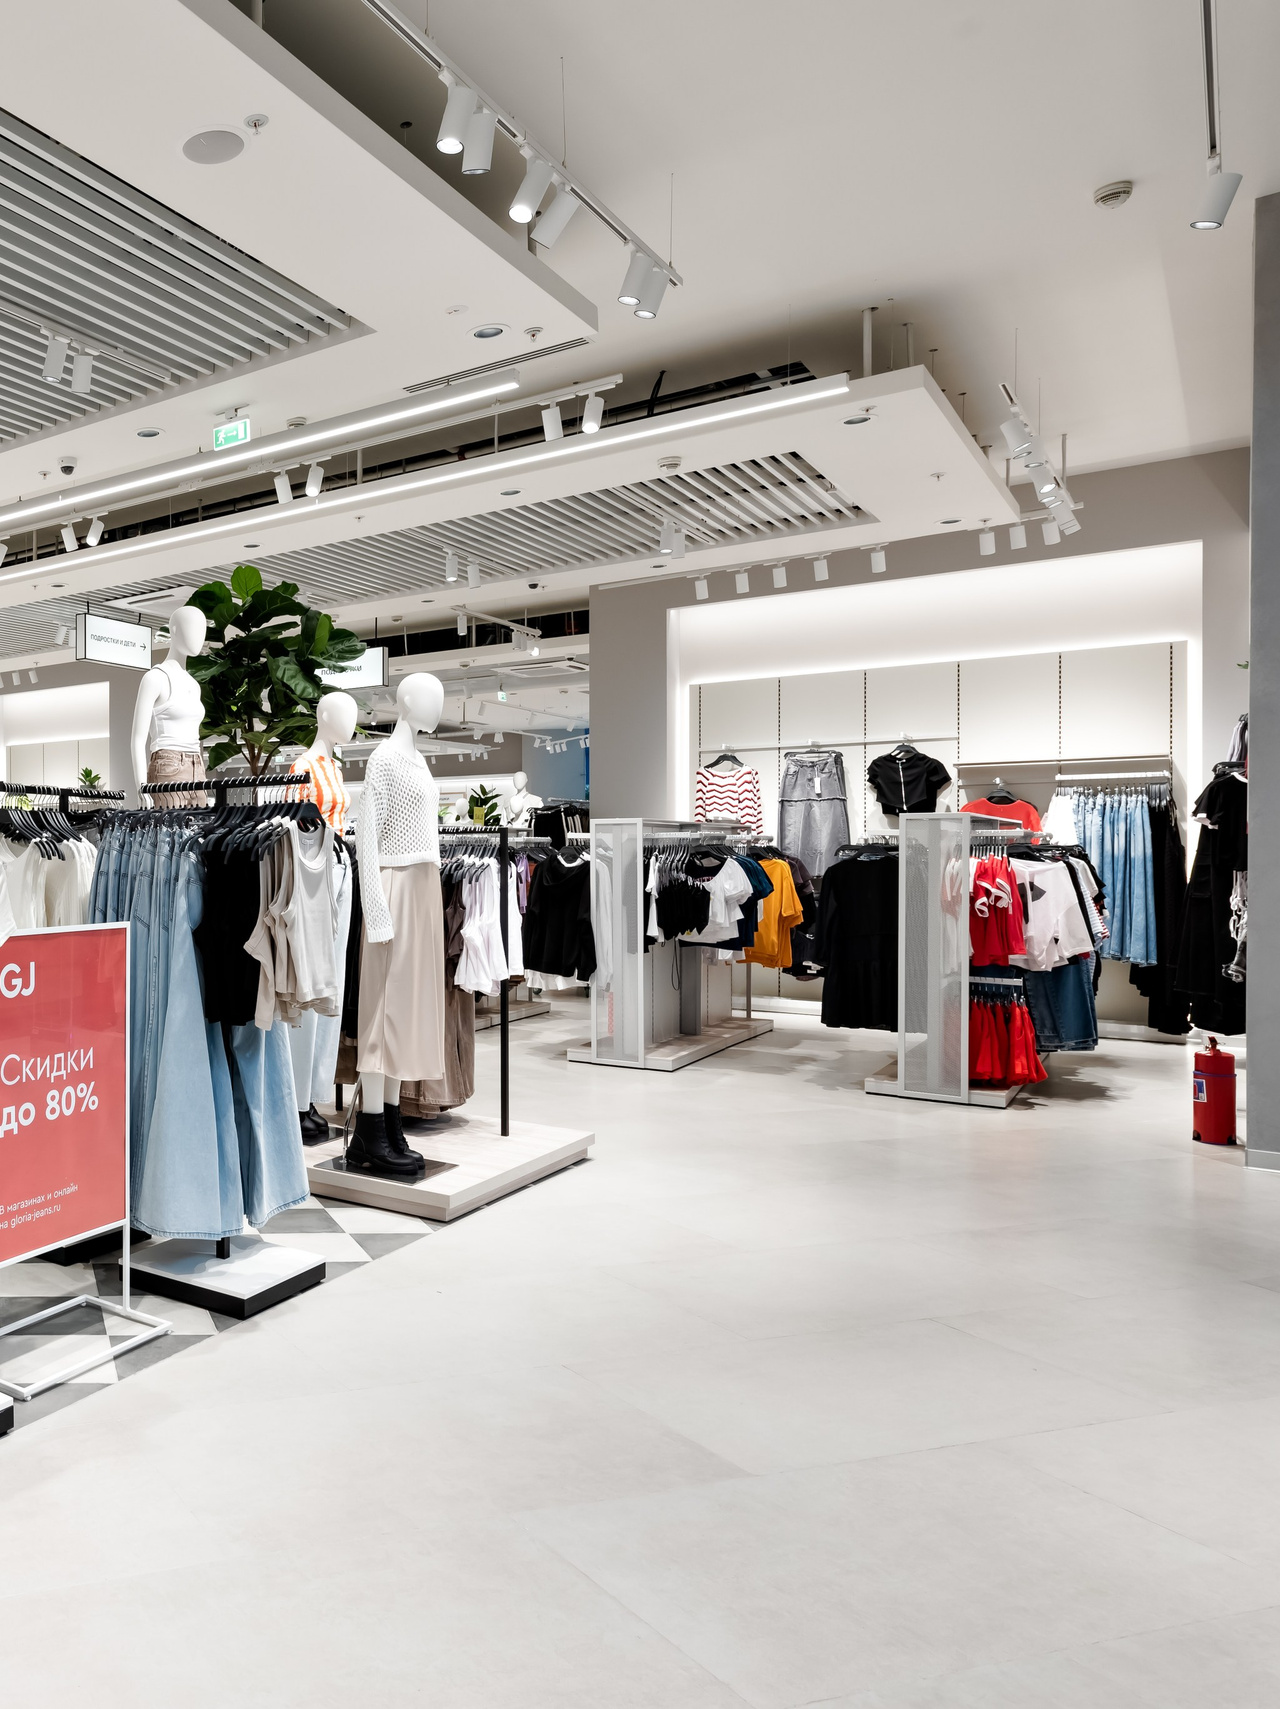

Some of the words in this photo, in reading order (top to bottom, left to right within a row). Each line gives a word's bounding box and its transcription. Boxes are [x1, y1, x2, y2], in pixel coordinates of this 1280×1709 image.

[91, 634, 119, 645] ПОДРОСТКИ
[124, 640, 136, 648] ДЕТИ
[0, 961, 35, 999] GJ
[0, 1047, 94, 1086] Скидки
[0, 1102, 36, 1139] до
[45, 1081, 99, 1121] 80%
[0, 1205, 5, 1215] В
[7, 1194, 45, 1213] магазинах
[47, 1192, 52, 1200] и
[53, 1182, 78, 1198] онлайн
[0, 1220, 9, 1230] на
[10, 1204, 61, 1229] gloria-jeans.ru
